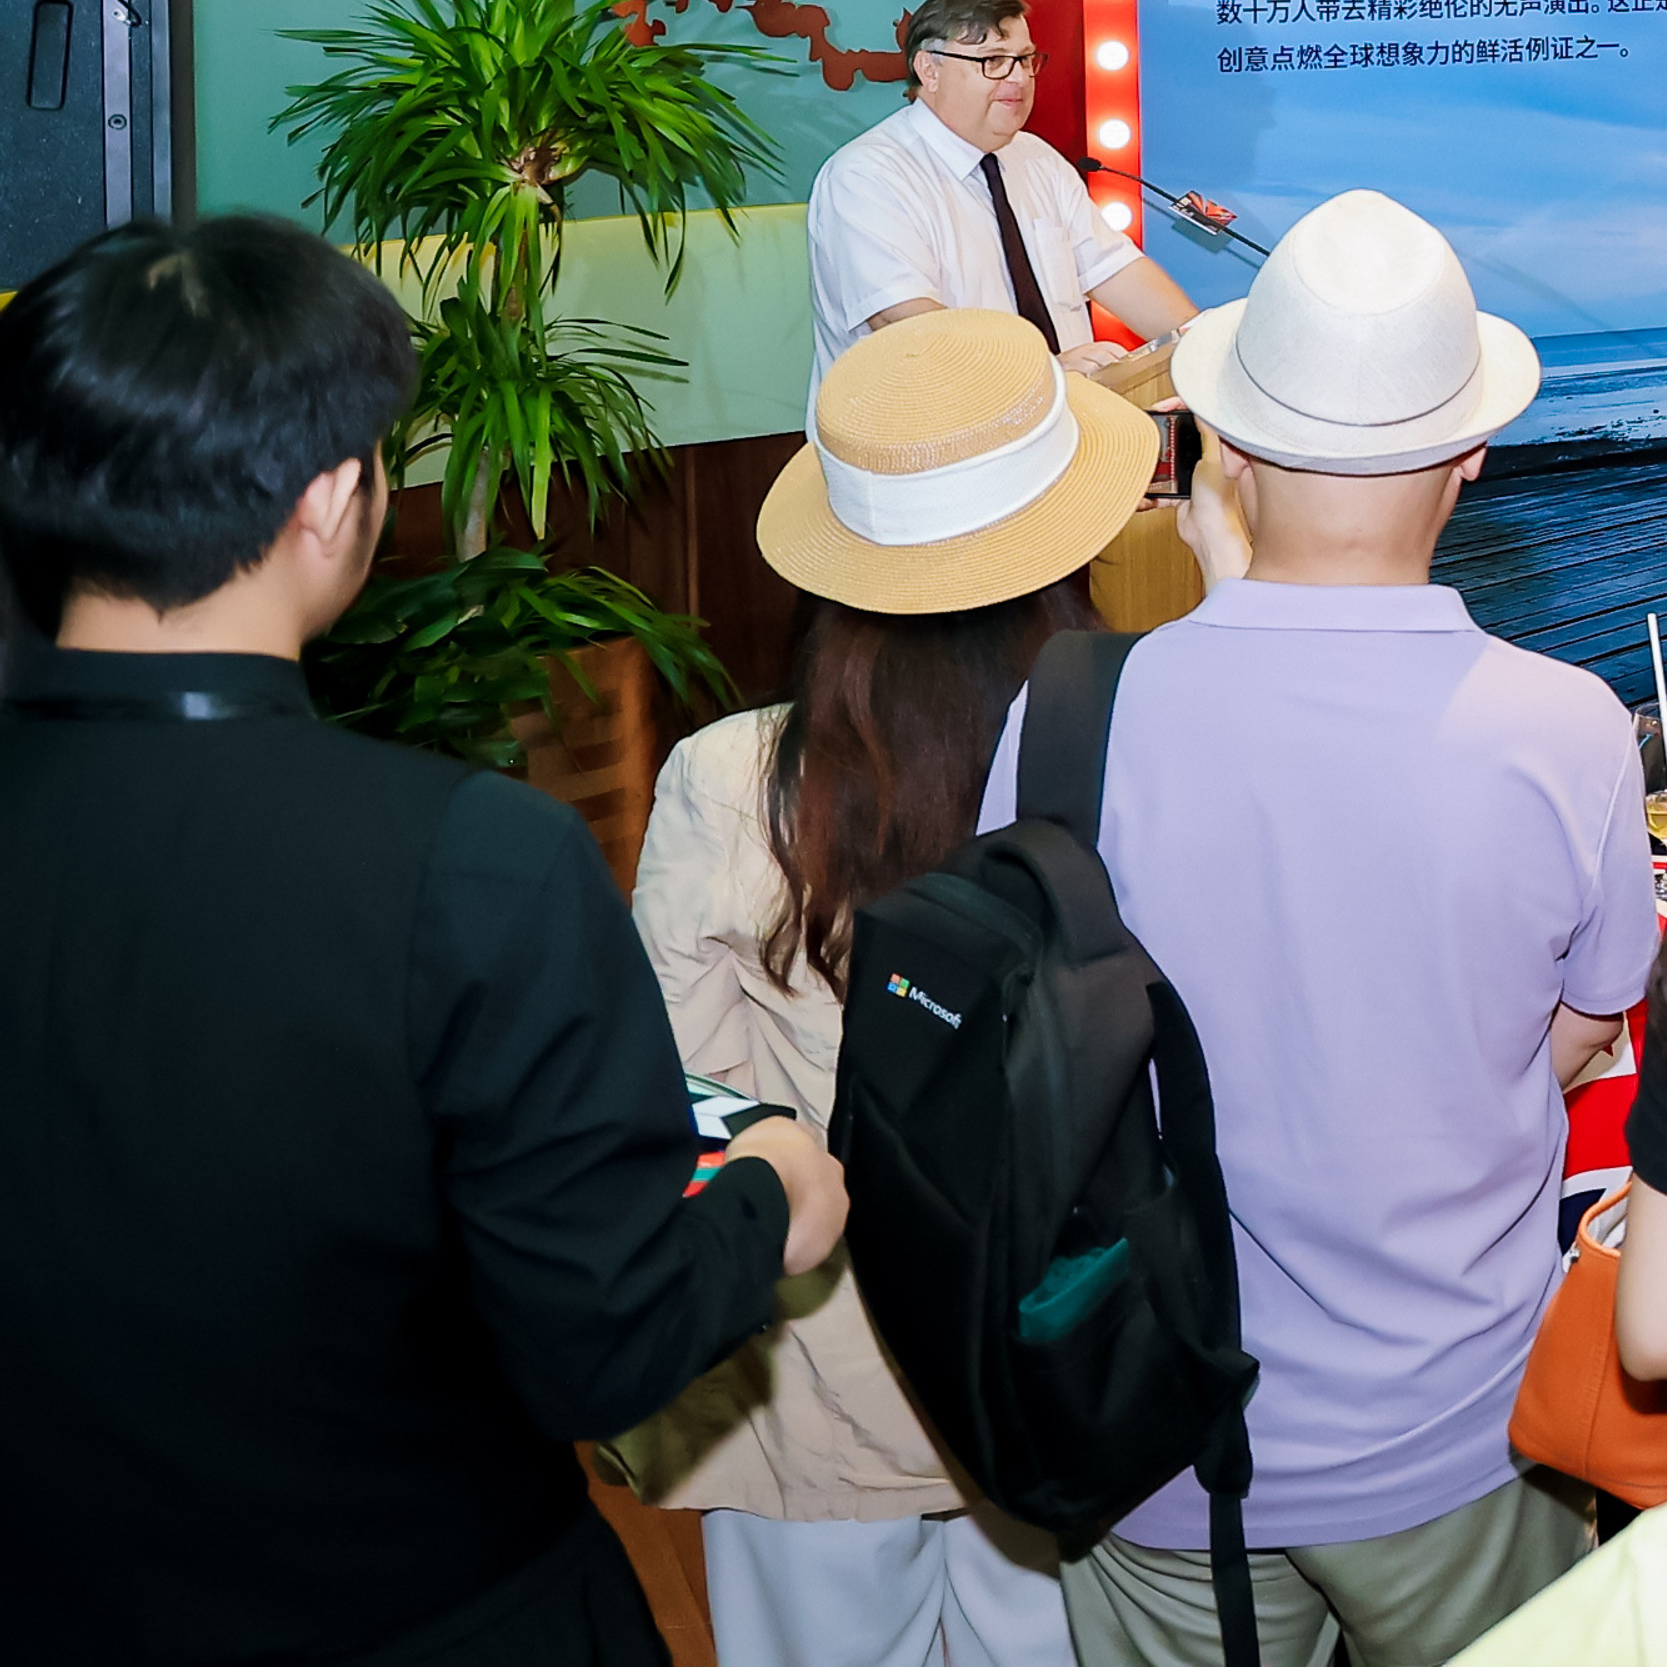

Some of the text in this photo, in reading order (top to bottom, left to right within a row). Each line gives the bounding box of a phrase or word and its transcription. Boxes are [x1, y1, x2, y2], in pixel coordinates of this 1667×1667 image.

[1217, 37, 1630, 73] 创意点燃全球想象力的鲜活例证之一。
[909, 986, 963, 1030] Microsoft
